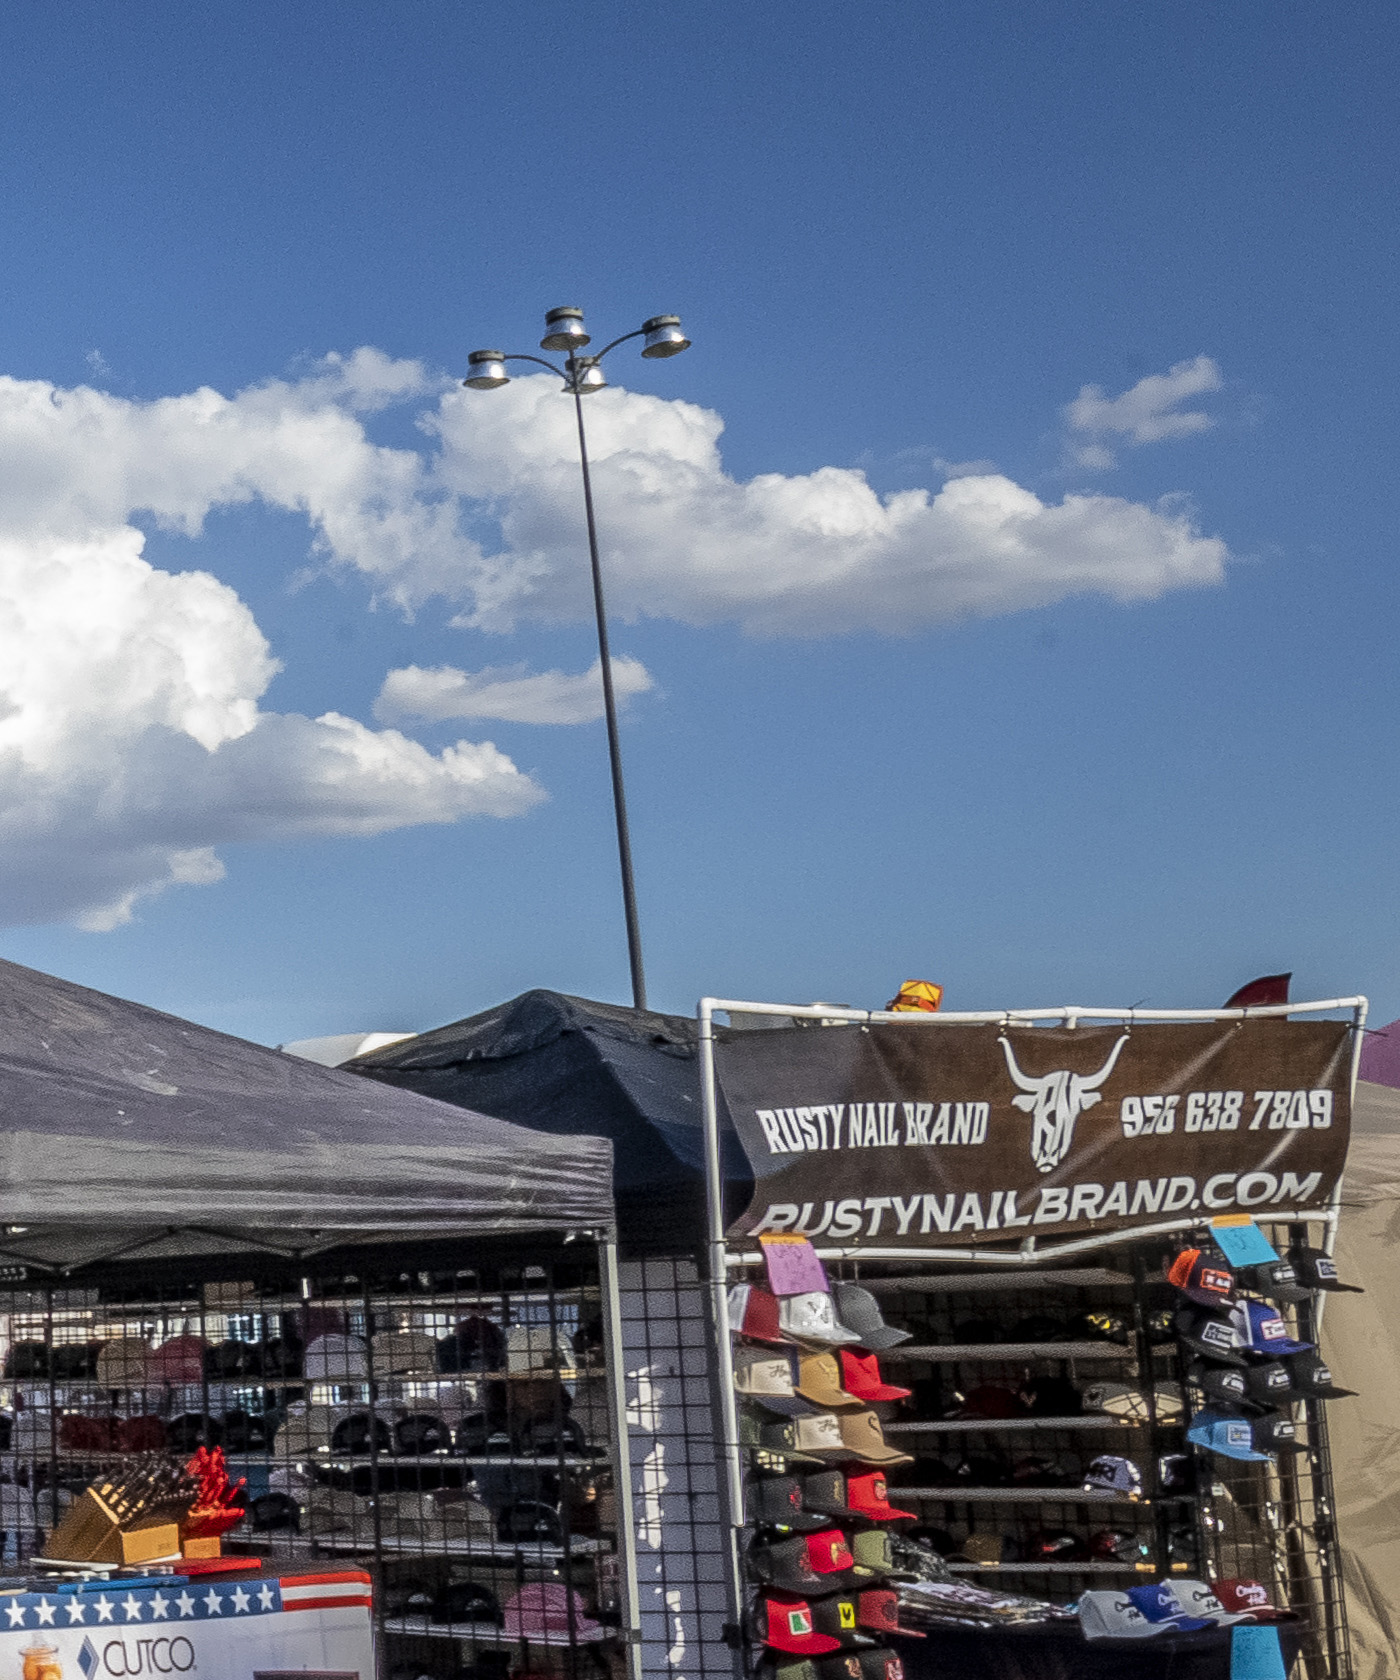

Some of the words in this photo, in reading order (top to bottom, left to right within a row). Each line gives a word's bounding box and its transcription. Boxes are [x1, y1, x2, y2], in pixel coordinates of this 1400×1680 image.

[756, 1104, 845, 1154] RUSTY
[848, 1102, 899, 1148] NAIL
[902, 1102, 989, 1146] BRAND
[1121, 1095, 1180, 1138] 956
[1185, 1091, 1244, 1133] 638
[1249, 1089, 1333, 1130] 7809
[747, 1171, 1323, 1239] RUSTYNAILBRAND.COM
[103, 1636, 194, 1677] CUTCO
